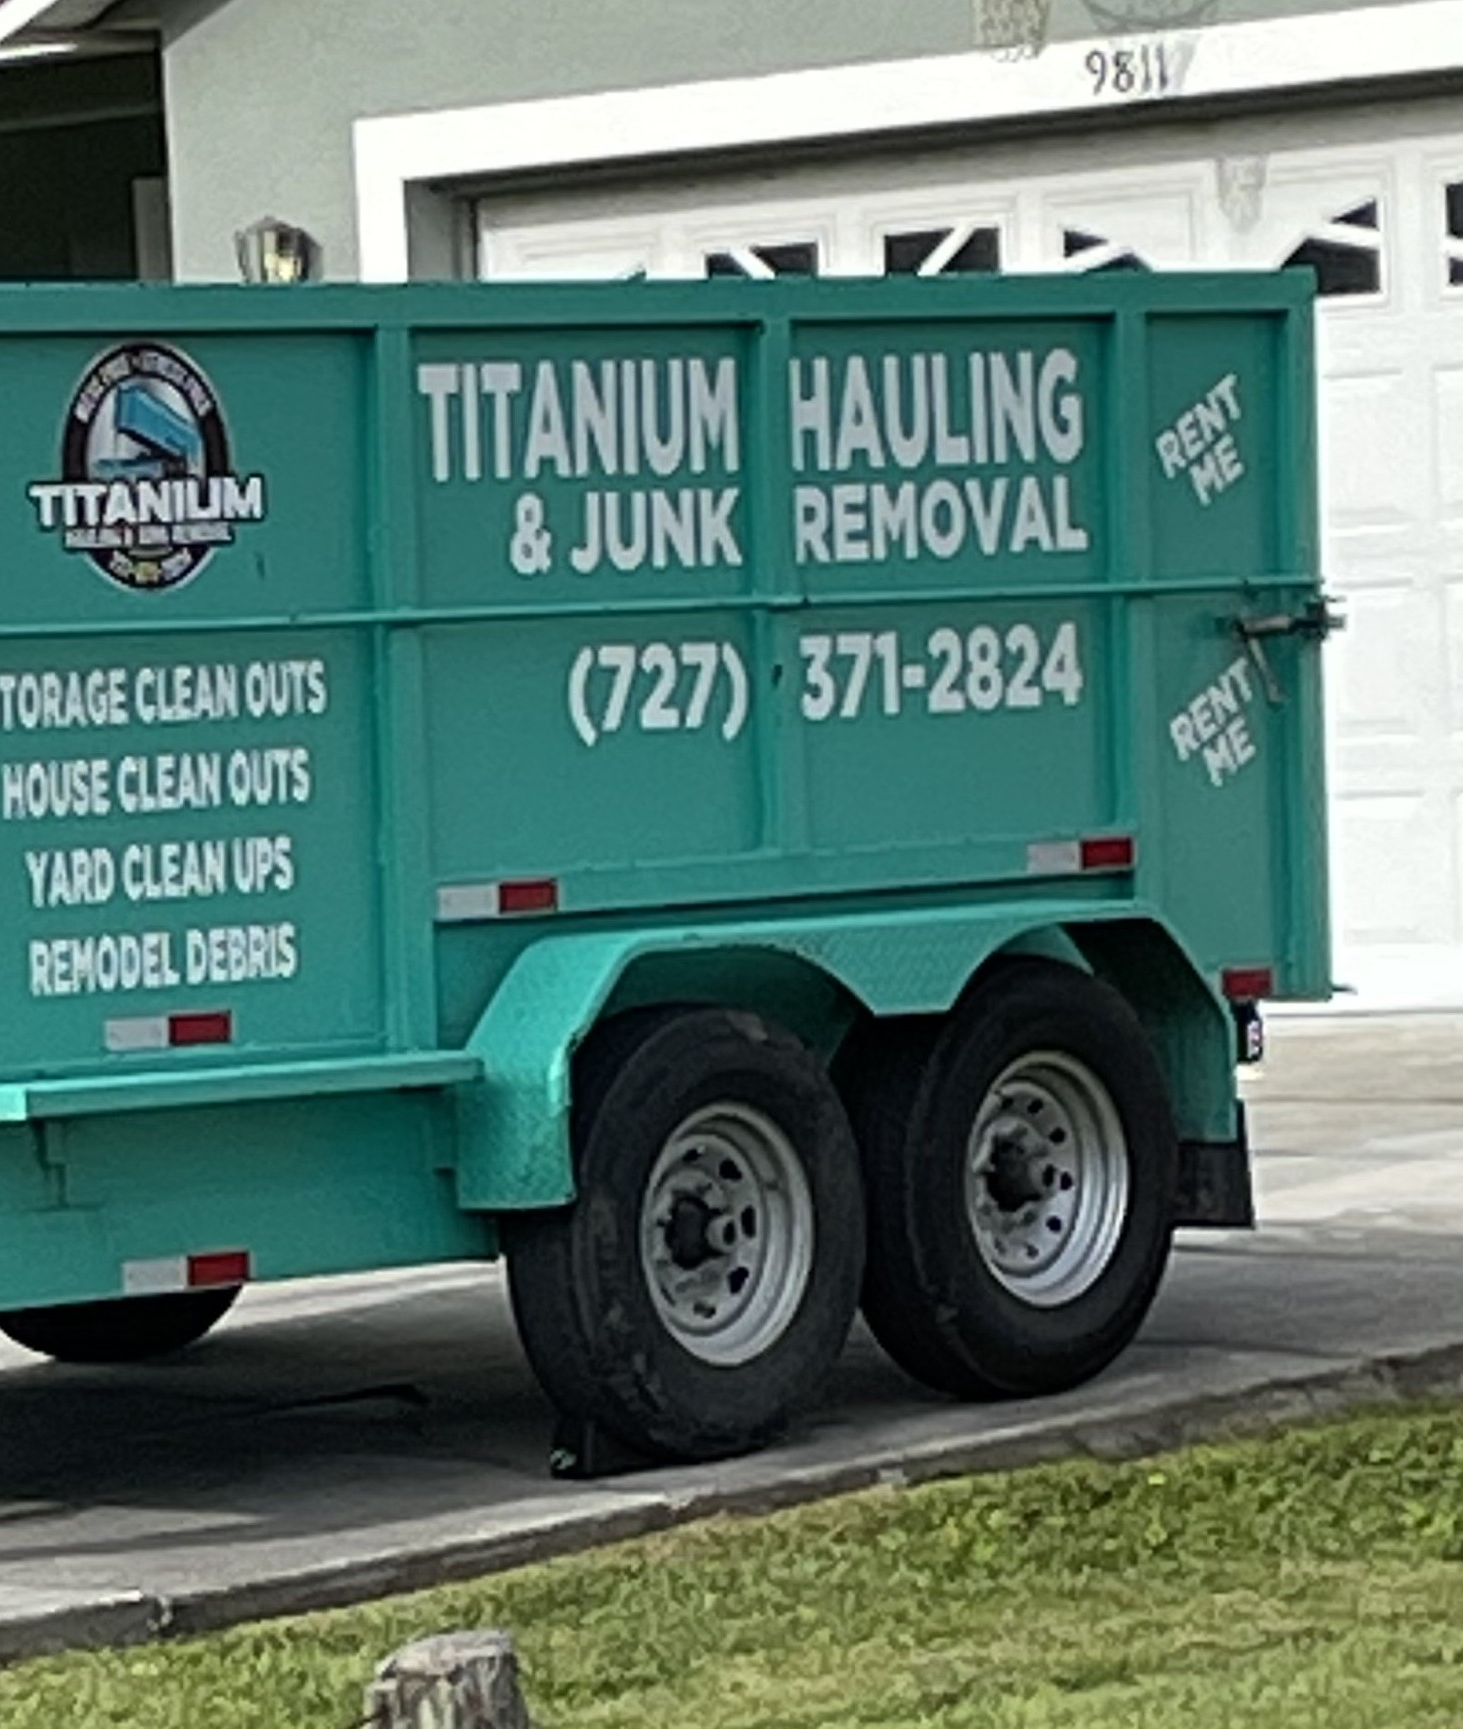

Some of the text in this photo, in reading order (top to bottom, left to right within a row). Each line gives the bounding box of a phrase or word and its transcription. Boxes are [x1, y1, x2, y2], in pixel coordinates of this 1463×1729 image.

[1085, 43, 1168, 96] 9811
[418, 348, 1084, 482] TITANIUM HAULING
[1155, 373, 1242, 479] RENT
[28, 476, 263, 527] TITANIUM
[1188, 434, 1244, 506] ME
[509, 475, 1089, 575] & JUNK REMOVAL
[135, 663, 238, 724] CLEAN
[244, 659, 328, 718] OUTS
[567, 621, 1085, 747] (727) 371-2824
[1169, 656, 1254, 762] RENT
[1, 747, 310, 820] HOUSE CLEAN OUTS
[1202, 717, 1256, 788] ME
[24, 835, 295, 908] YARD CLEAN UPS
[28, 922, 298, 998] REMODEL DEBRIS
